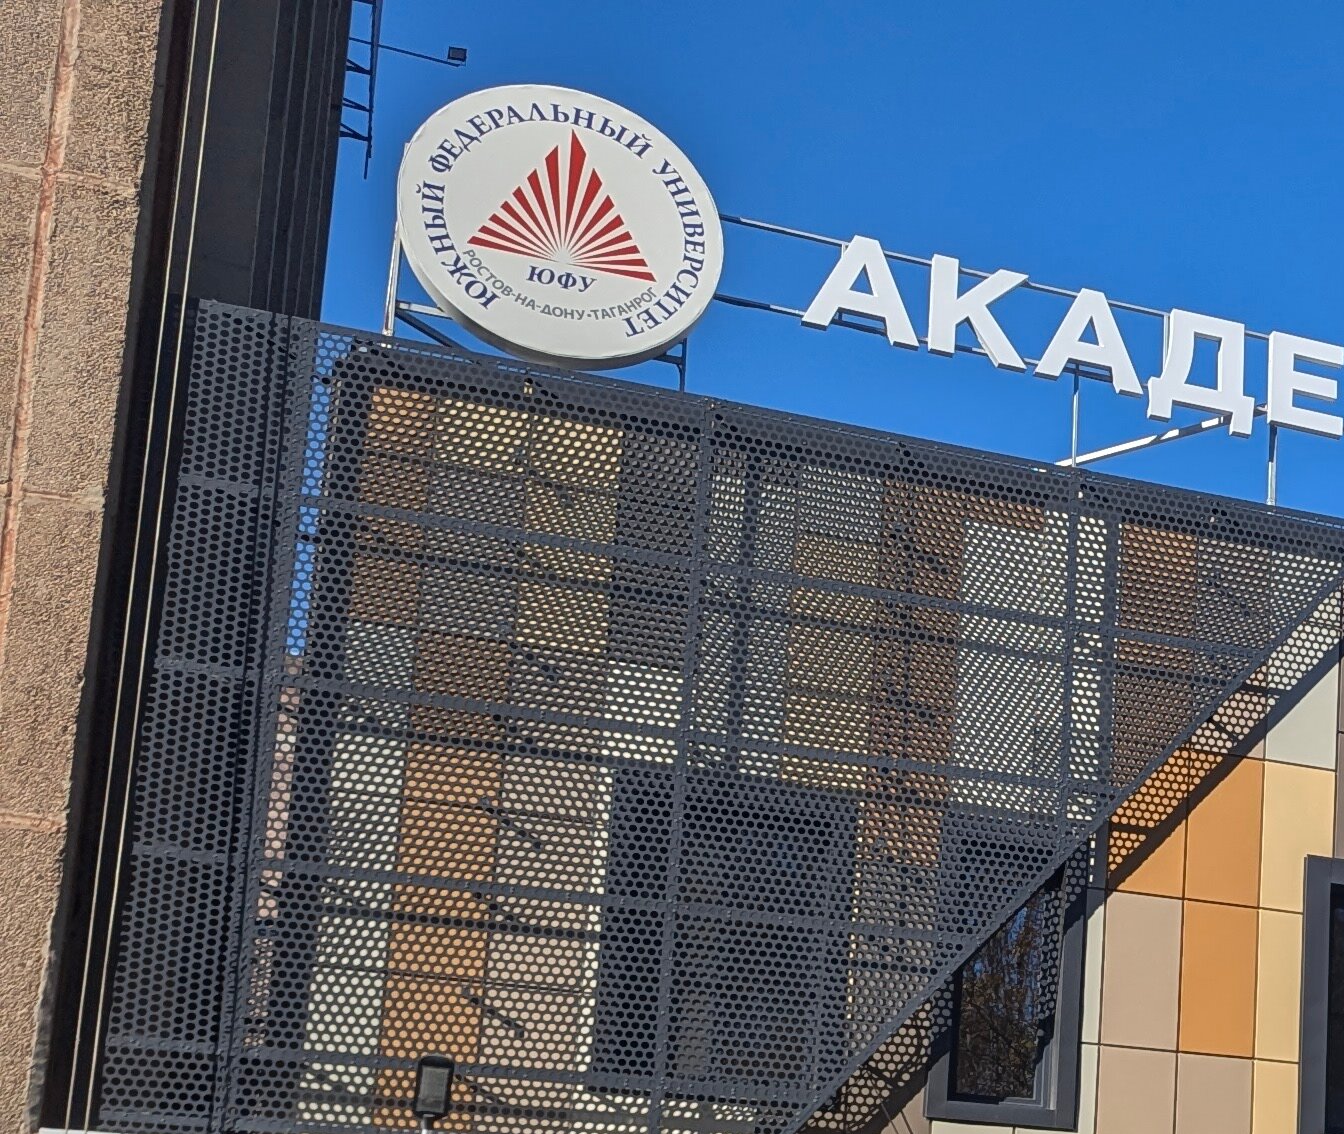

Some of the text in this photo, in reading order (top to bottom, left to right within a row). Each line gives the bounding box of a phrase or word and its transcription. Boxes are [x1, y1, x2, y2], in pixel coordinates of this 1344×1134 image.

[415, 102, 706, 338] ЮЖНЫЙ ФЕДЕРАЛЬНЫЙ УНИВЕРСИТЕТ
[525, 265, 597, 293] ЮФУ
